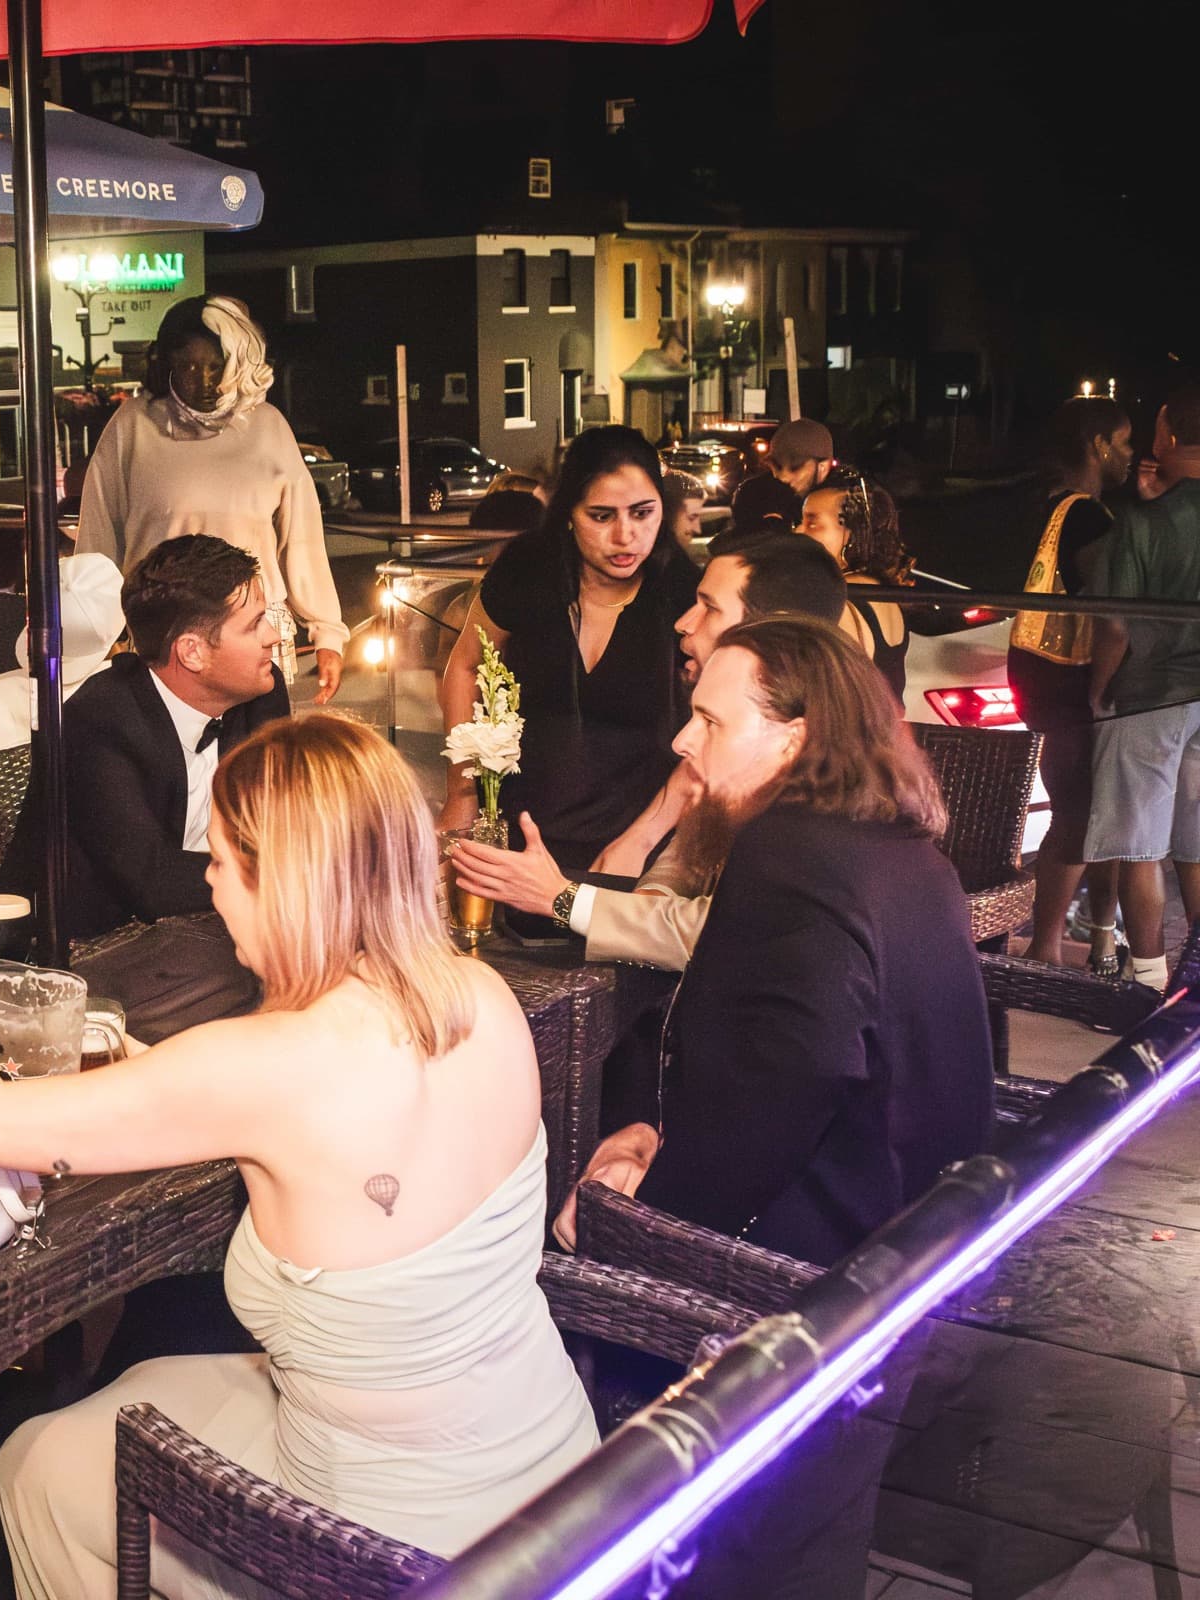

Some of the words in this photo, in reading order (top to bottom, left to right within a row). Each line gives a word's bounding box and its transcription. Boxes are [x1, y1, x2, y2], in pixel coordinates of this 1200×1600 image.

[55, 177, 177, 202] CREEMORE
[101, 300, 127, 313] TAKE
[130, 299, 152, 312] OUT
